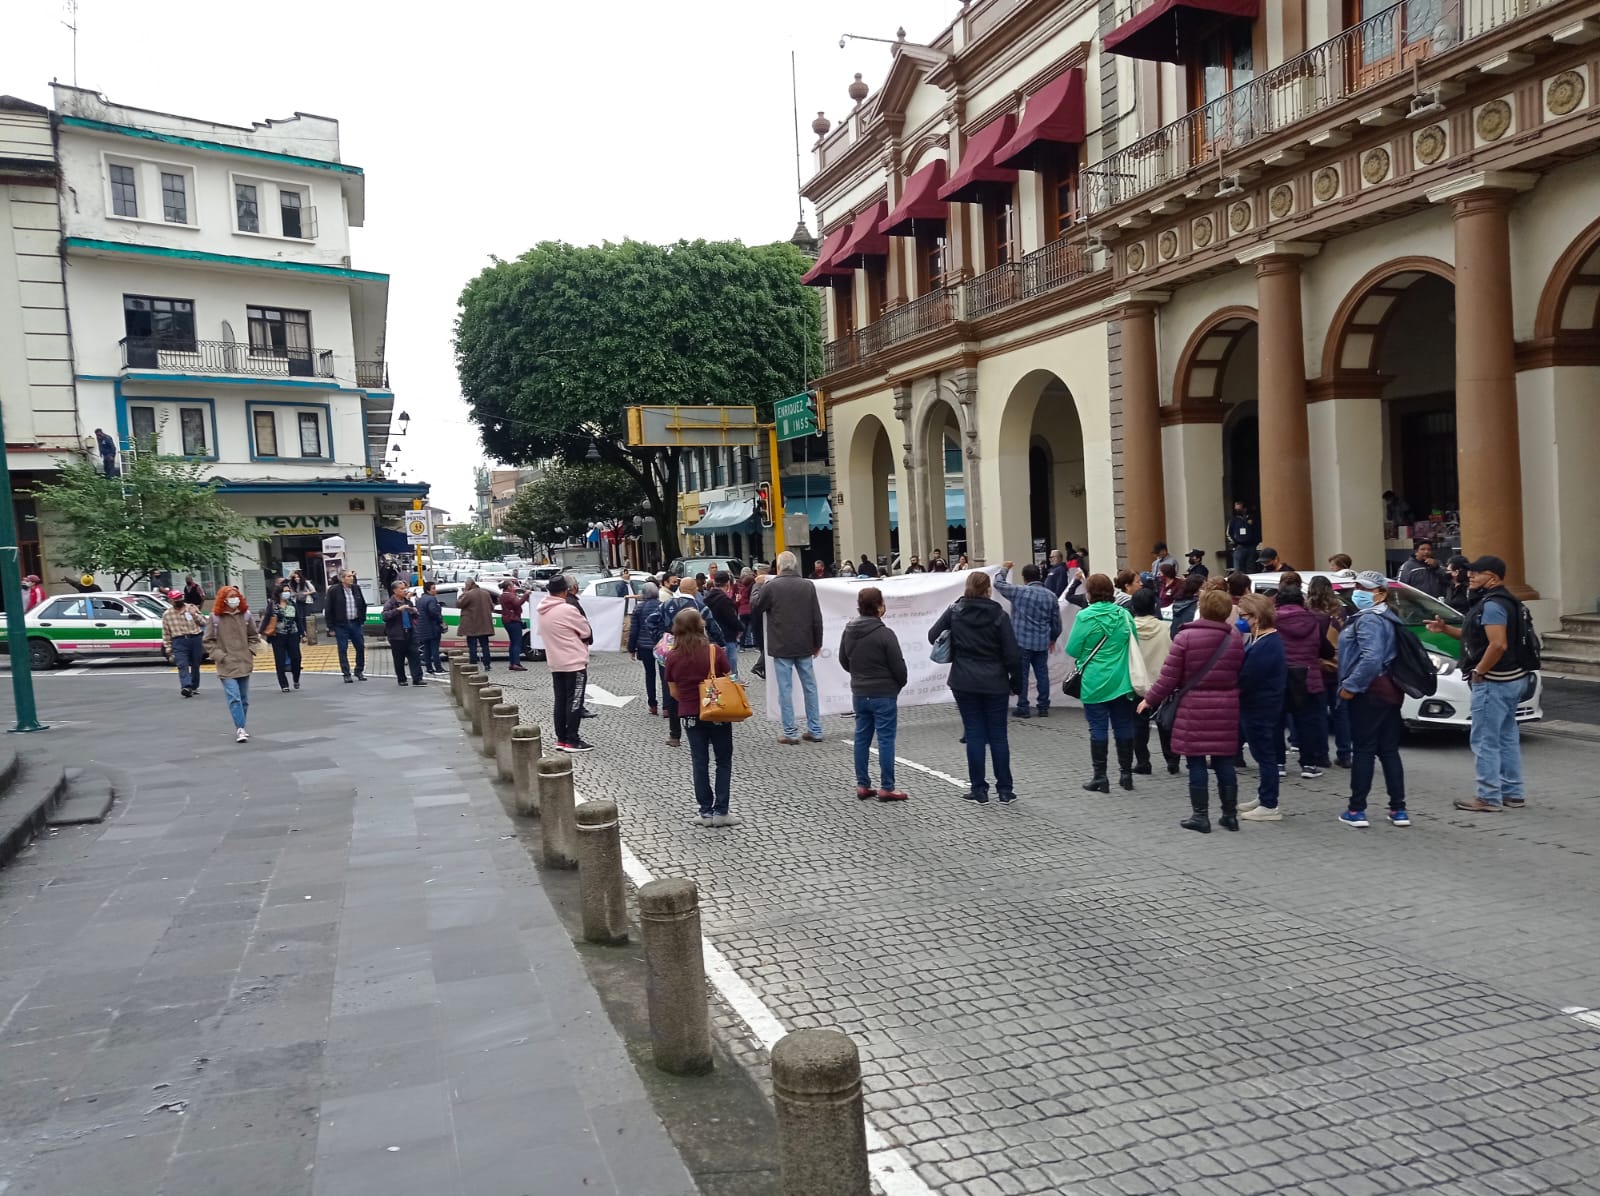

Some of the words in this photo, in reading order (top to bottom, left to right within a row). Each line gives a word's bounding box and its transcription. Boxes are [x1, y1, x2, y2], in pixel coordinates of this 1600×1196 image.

[777, 400, 804, 418] ENRIQUEZ
[793, 416, 809, 432] IMSS
[255, 514, 339, 528] DEVLYN
[113, 628, 131, 637] TAXI
